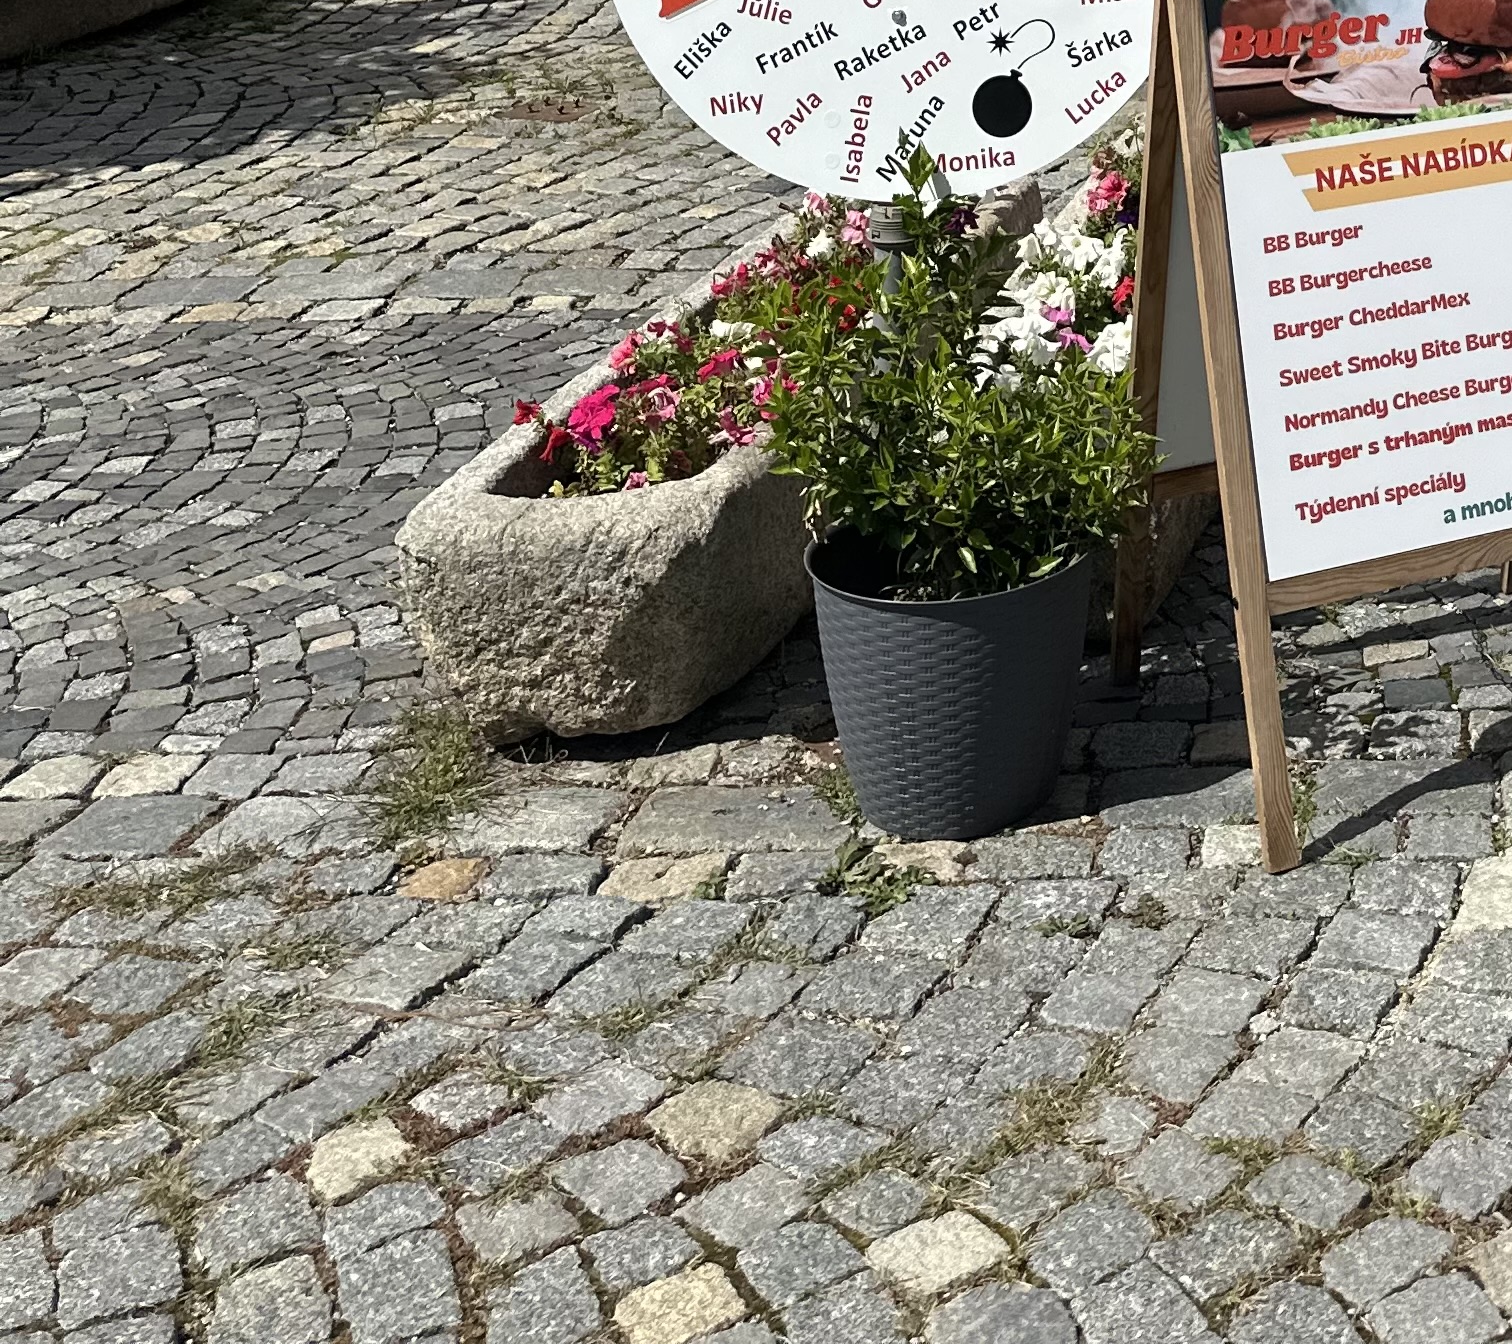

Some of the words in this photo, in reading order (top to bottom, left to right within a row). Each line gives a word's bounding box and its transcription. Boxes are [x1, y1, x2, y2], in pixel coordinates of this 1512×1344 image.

[953, 3, 999, 40] Petr
[1220, 11, 1390, 62] Burger
[1395, 27, 1423, 46] JH
[674, 22, 732, 79] Eliška
[756, 22, 838, 74] Frantík
[834, 25, 926, 80] Raketka
[1065, 30, 1132, 67] Šárka
[901, 52, 951, 93] Jana
[710, 92, 763, 116] Niky
[767, 93, 822, 146] Pavla
[1065, 72, 1126, 124] Lucka
[840, 95, 872, 182] Isabela
[1315, 153, 1394, 192] NAŠE
[1264, 235, 1290, 253] BB
[1295, 225, 1363, 248] Burger
[1269, 278, 1295, 297] BB
[1300, 257, 1432, 291] Burgercheese
[1274, 316, 1343, 340] Burger
[1349, 293, 1470, 325] CheddarMex
[1280, 361, 1343, 386] Sweet
[1348, 349, 1417, 373] Smoky
[1422, 340, 1461, 360] Bite
[1285, 398, 1388, 432] Normandy
[1393, 386, 1460, 409] Cheese
[1290, 445, 1362, 471] Burger
[1369, 441, 1379, 454] s
[1384, 422, 1473, 451] trhaným
[1295, 487, 1379, 523] Týdenní
[1385, 472, 1466, 505] speciály
[1444, 509, 1456, 523] a
